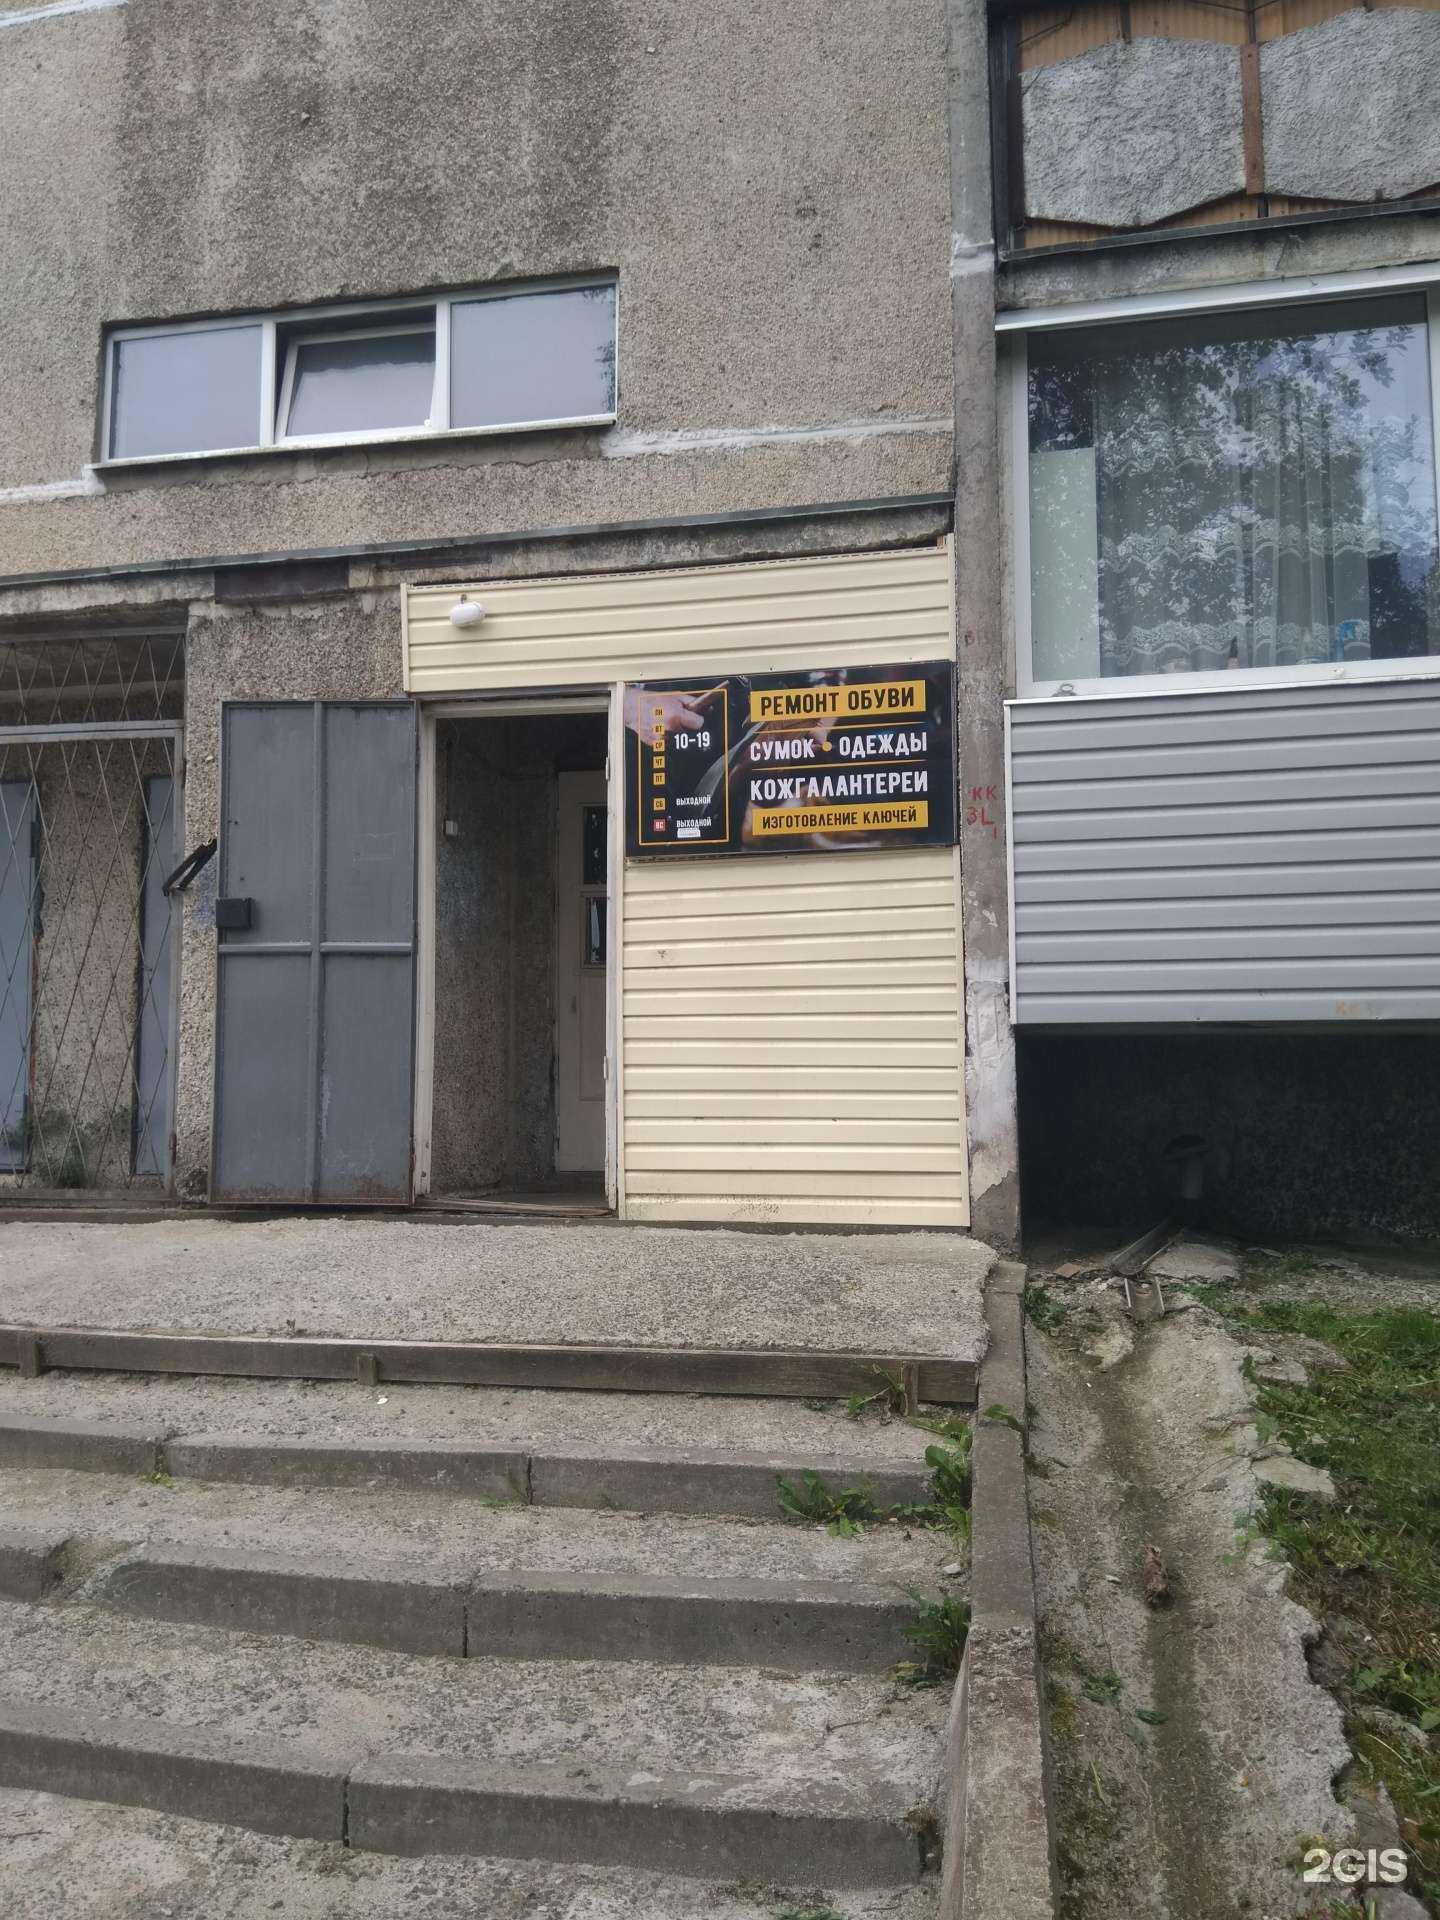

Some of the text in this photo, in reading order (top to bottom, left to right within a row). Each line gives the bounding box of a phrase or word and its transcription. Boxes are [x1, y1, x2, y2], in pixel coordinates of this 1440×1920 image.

[760, 686, 914, 716] РЕМОНТ ОБУВИ
[674, 731, 711, 749] 10-19
[750, 731, 927, 761] СУМОК ОДЕЖДЫ
[750, 770, 928, 801] КОЖГАЛАНТЕРЕИ
[676, 795, 711, 806] ВЫХОДНОЙ
[676, 816, 712, 828] ВЫХОДНОЙ
[863, 805, 917, 824] КЛЮЧЕЙ
